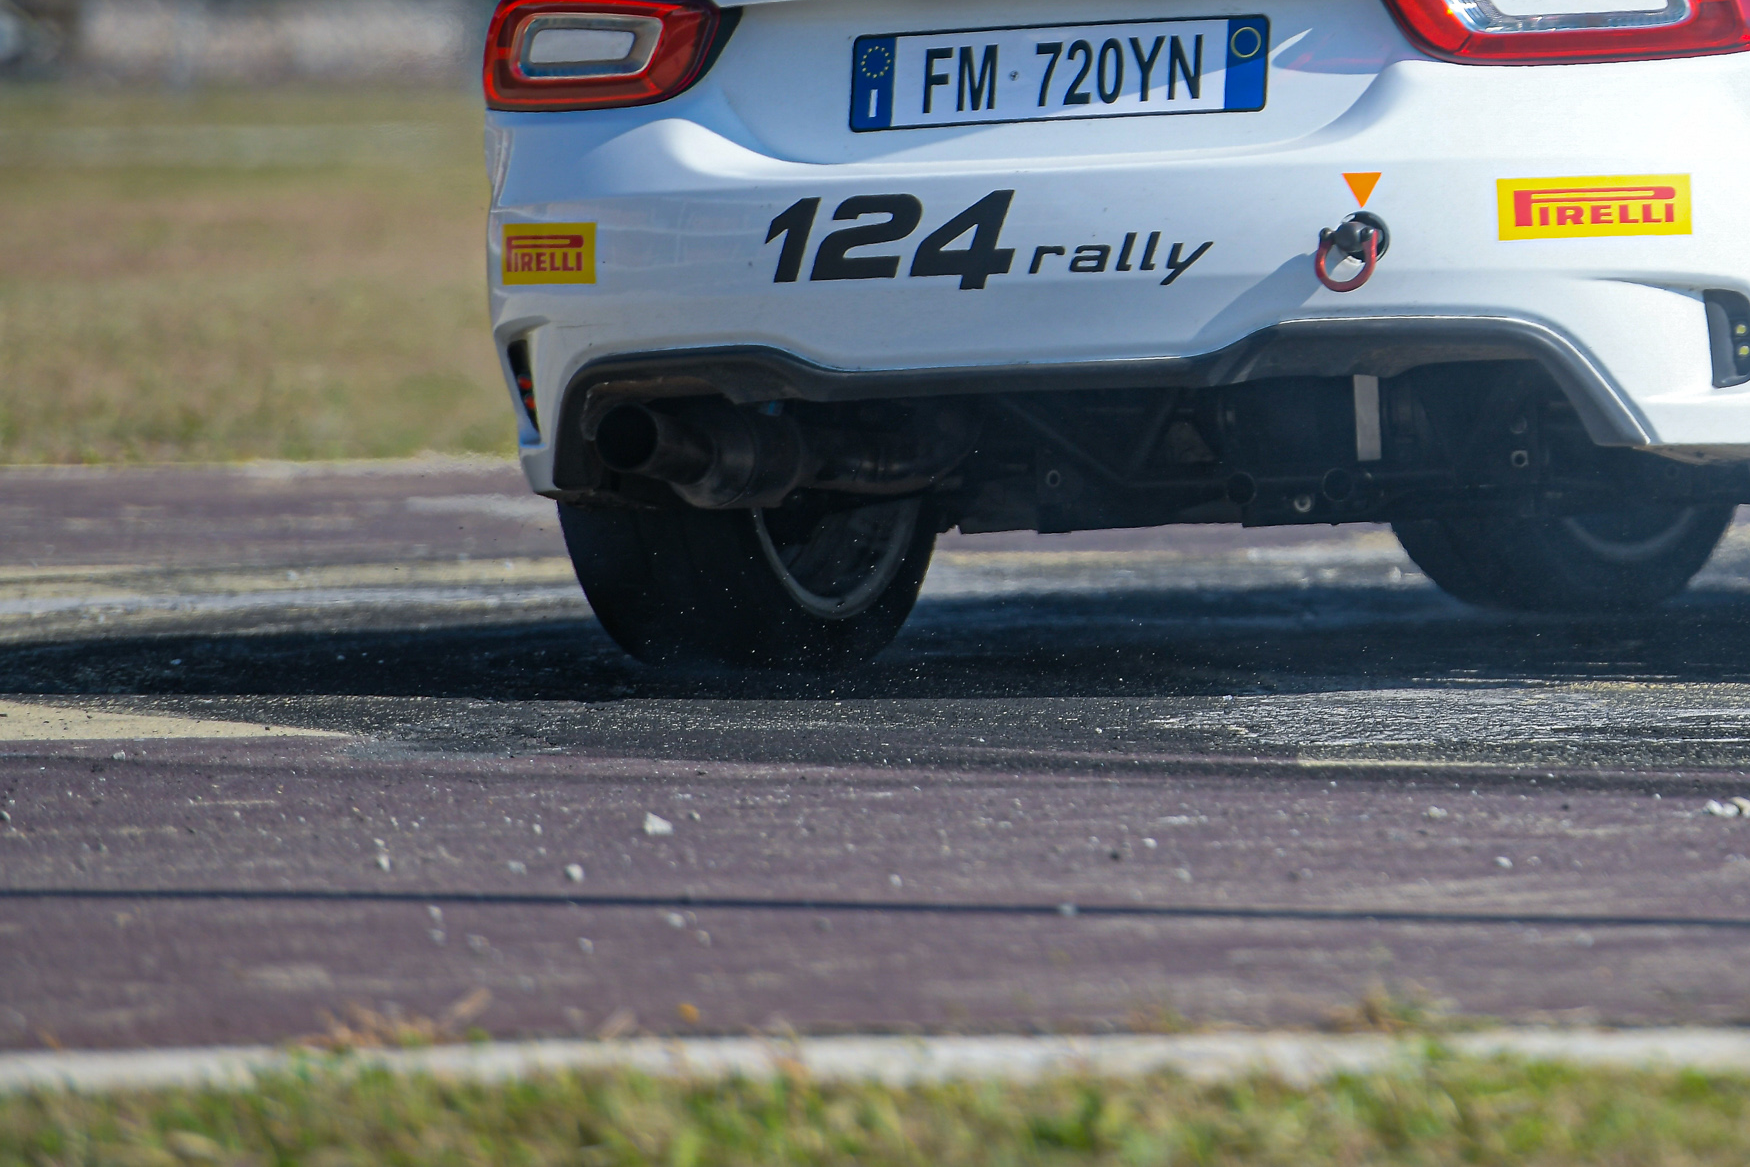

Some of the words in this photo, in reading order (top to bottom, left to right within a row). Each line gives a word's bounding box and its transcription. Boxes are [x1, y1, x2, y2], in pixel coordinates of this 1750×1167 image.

[922, 44, 998, 114] FM
[1035, 34, 1203, 107] 720YN
[1513, 186, 1677, 228] PIRELLI
[506, 235, 584, 272] PIRELLI
[765, 189, 1015, 290] 124
[1028, 231, 1214, 286] rally
